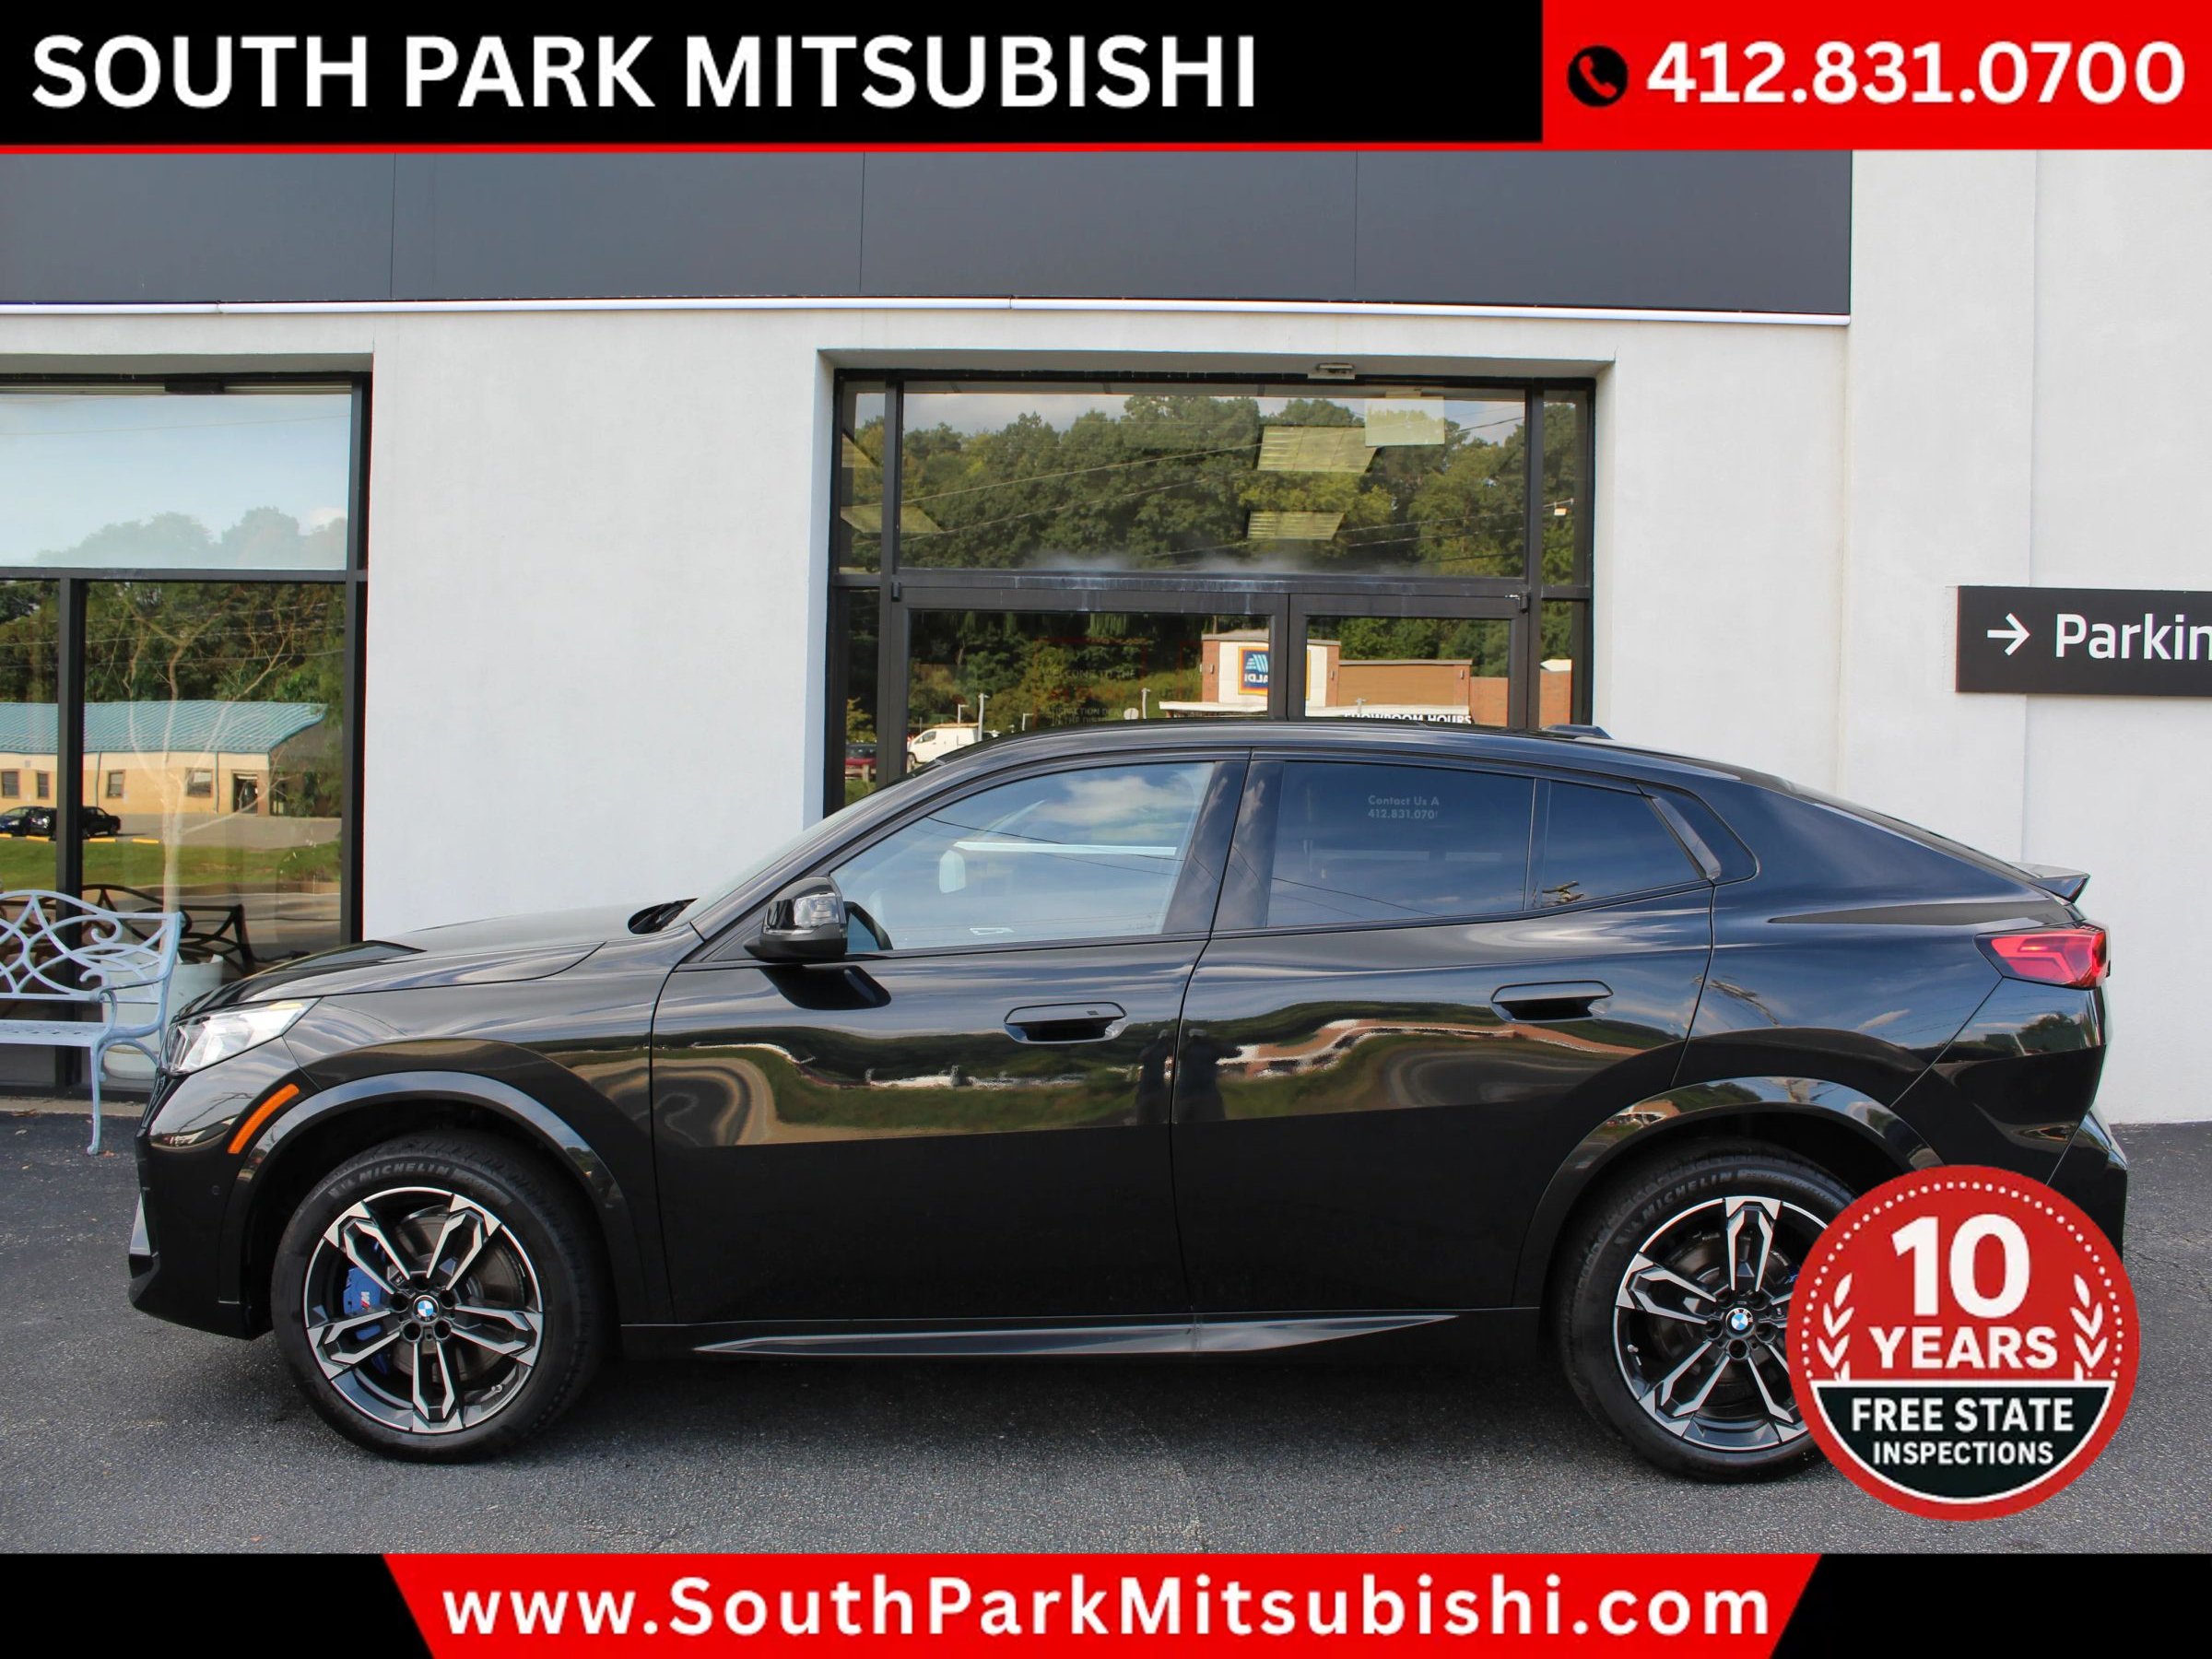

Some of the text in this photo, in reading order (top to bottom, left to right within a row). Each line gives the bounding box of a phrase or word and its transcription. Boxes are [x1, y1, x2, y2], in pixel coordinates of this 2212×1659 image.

[1368, 794, 1410, 805] Contact
[1414, 795, 1428, 805] Us
[359, 1162, 451, 1183] MICHELIN
[1641, 1171, 1733, 1218] MICHELIN
